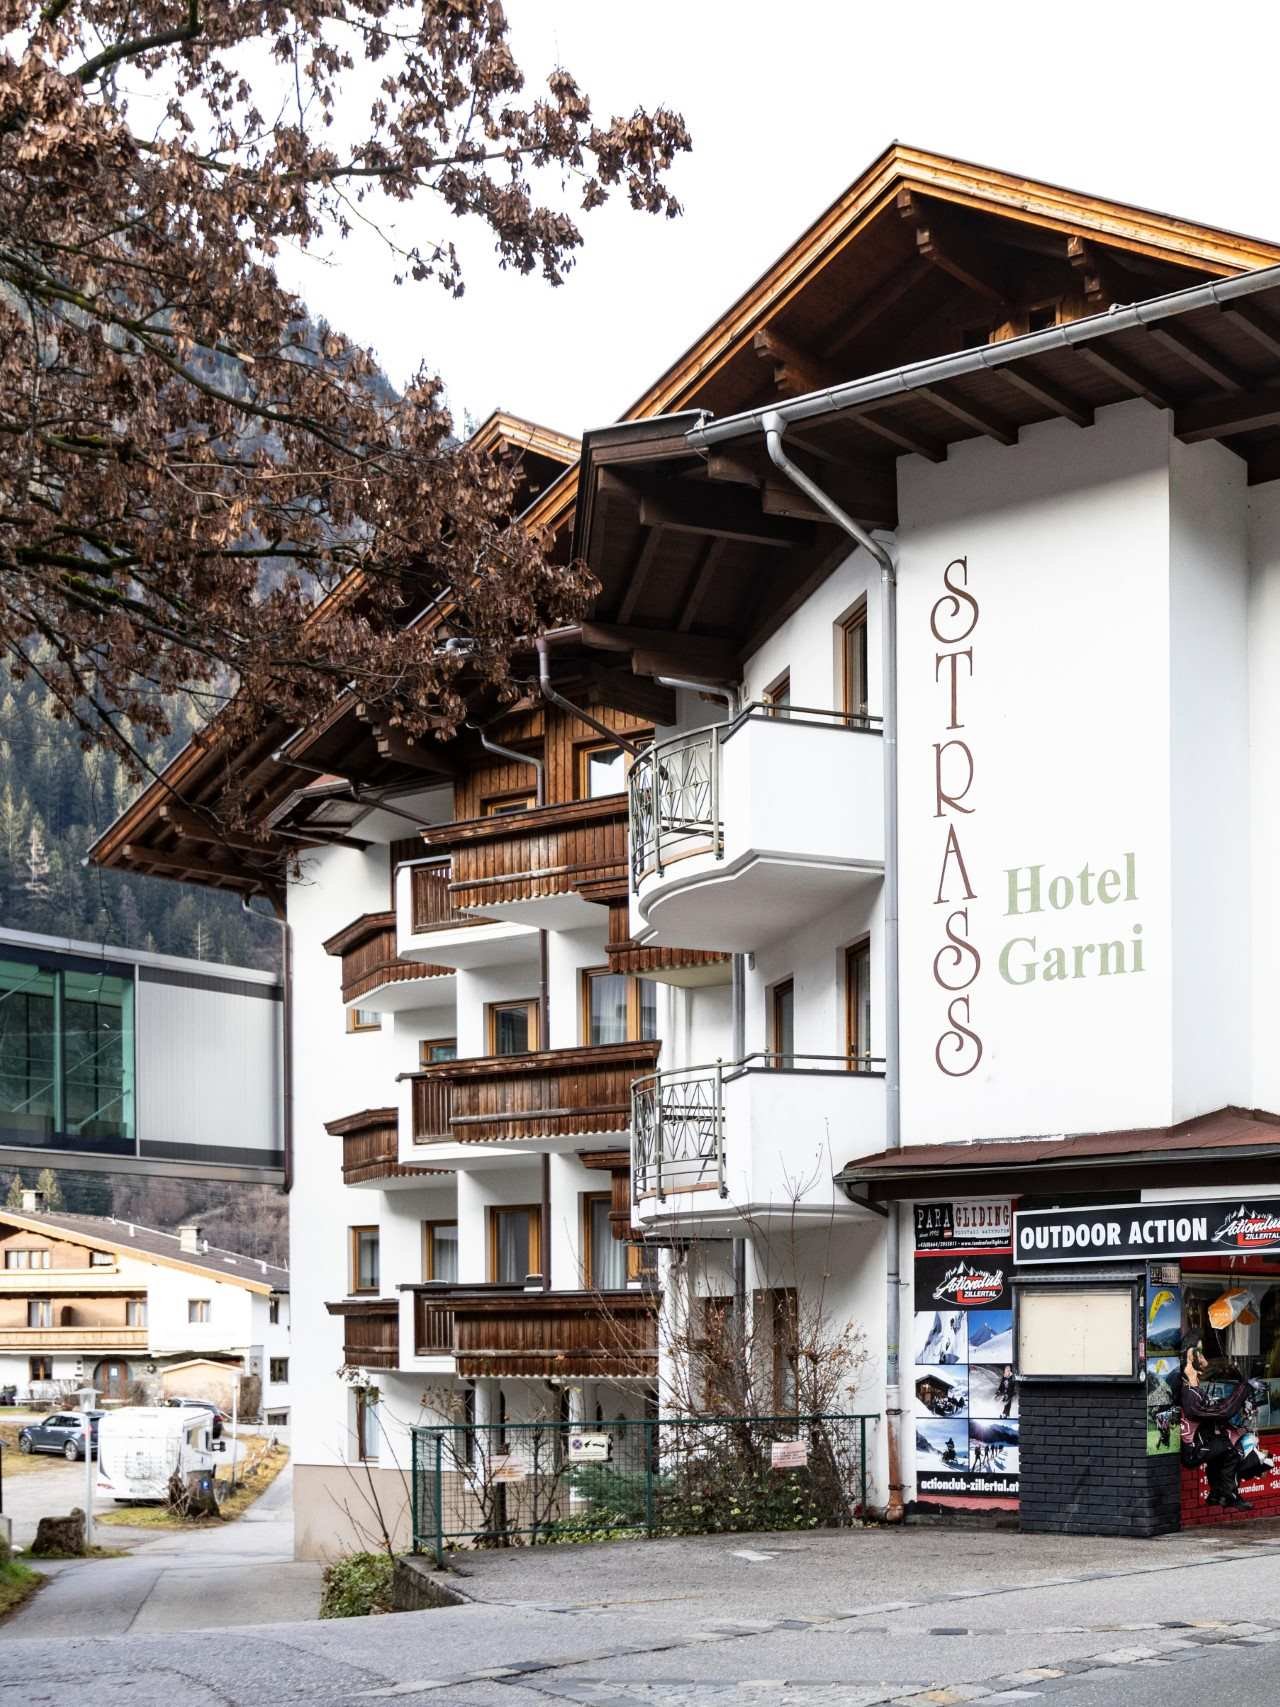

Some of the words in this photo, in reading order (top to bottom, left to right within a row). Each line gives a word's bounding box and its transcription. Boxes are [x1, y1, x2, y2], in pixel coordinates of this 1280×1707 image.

[930, 556, 983, 1077] STRASS
[1002, 852, 1140, 916] Hotel
[998, 923, 1147, 986] Garni
[917, 1207, 951, 1229] PARA
[955, 1205, 1010, 1228] GLIDING
[1020, 1222, 1121, 1250] OUTDOOR
[1128, 1217, 1207, 1244] ACTION
[1245, 1231, 1280, 1240] ZILLERTAL
[932, 1269, 1004, 1300] Actionclub
[964, 1290, 997, 1298] ZILLERTAL
[921, 1477, 1020, 1492] actionclub-zillertal.at
[1272, 1466, 1280, 1476] Ski
